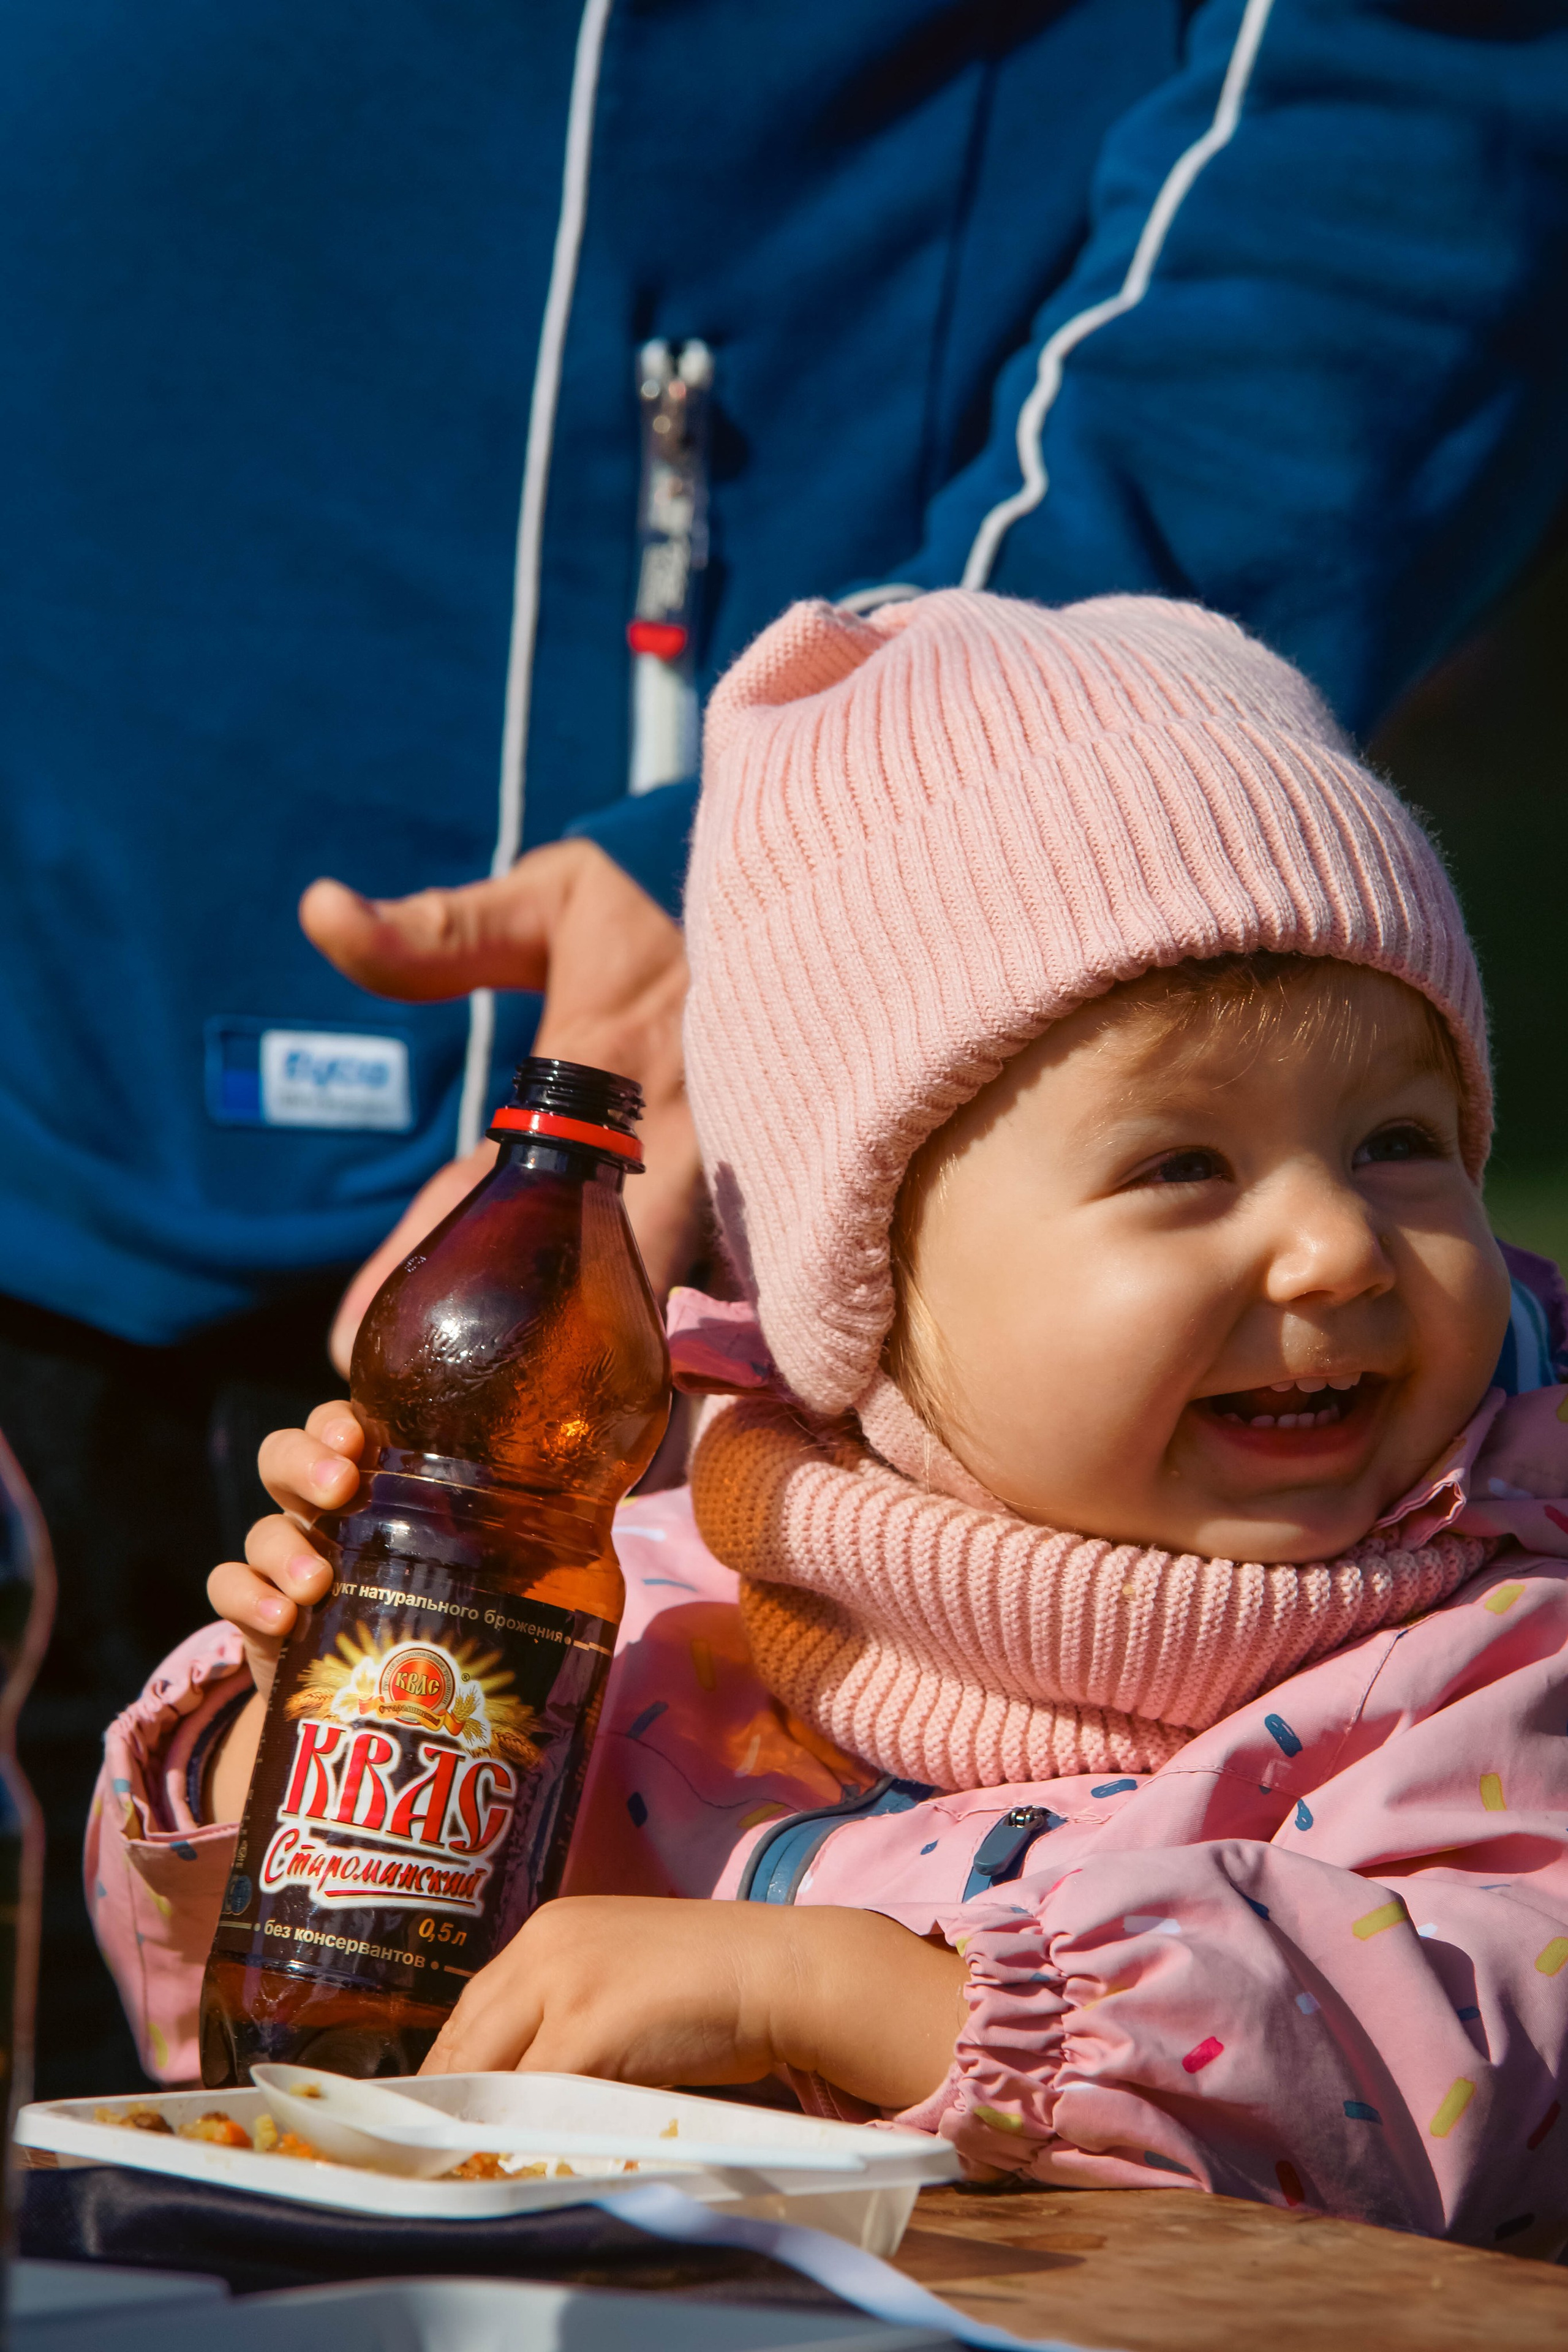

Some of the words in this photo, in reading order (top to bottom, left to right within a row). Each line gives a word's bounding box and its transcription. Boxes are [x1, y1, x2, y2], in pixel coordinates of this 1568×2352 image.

[332, 1582, 357, 1597] укт
[358, 1585, 480, 1621] натурального
[484, 1609, 564, 1643] брожения
[394, 1672, 440, 1696] КВАС
[282, 1723, 514, 1855] КВАС
[265, 1828, 488, 1899] Староминский
[264, 1918, 291, 1939] без
[293, 1928, 426, 1969] консервантов
